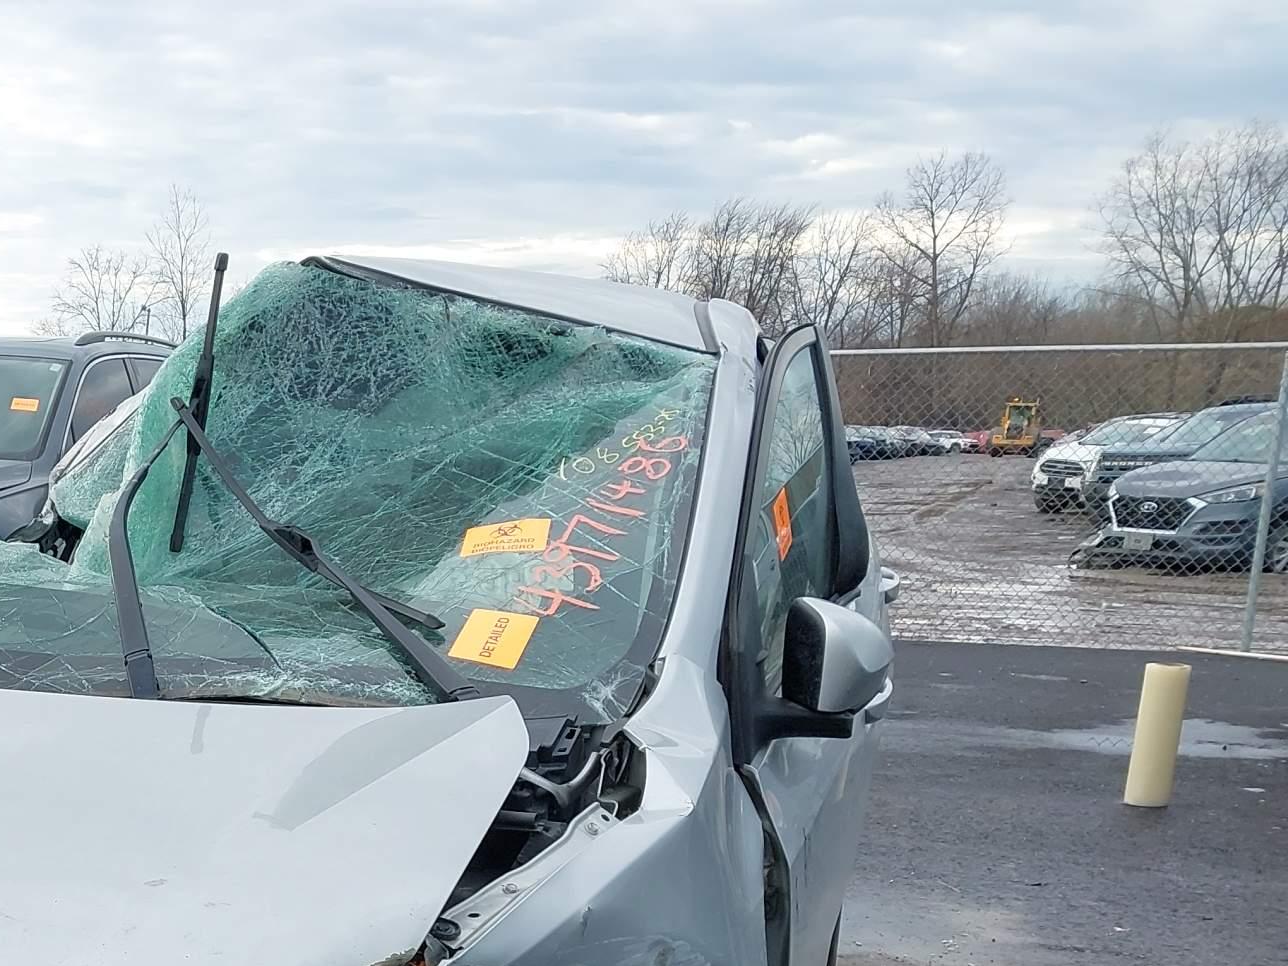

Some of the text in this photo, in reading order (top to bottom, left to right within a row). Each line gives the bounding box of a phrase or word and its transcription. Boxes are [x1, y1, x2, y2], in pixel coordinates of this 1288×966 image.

[472, 537, 536, 549] BIOHAZARD
[513, 435, 689, 617] 43971486
[478, 616, 511, 658] DETAILED
